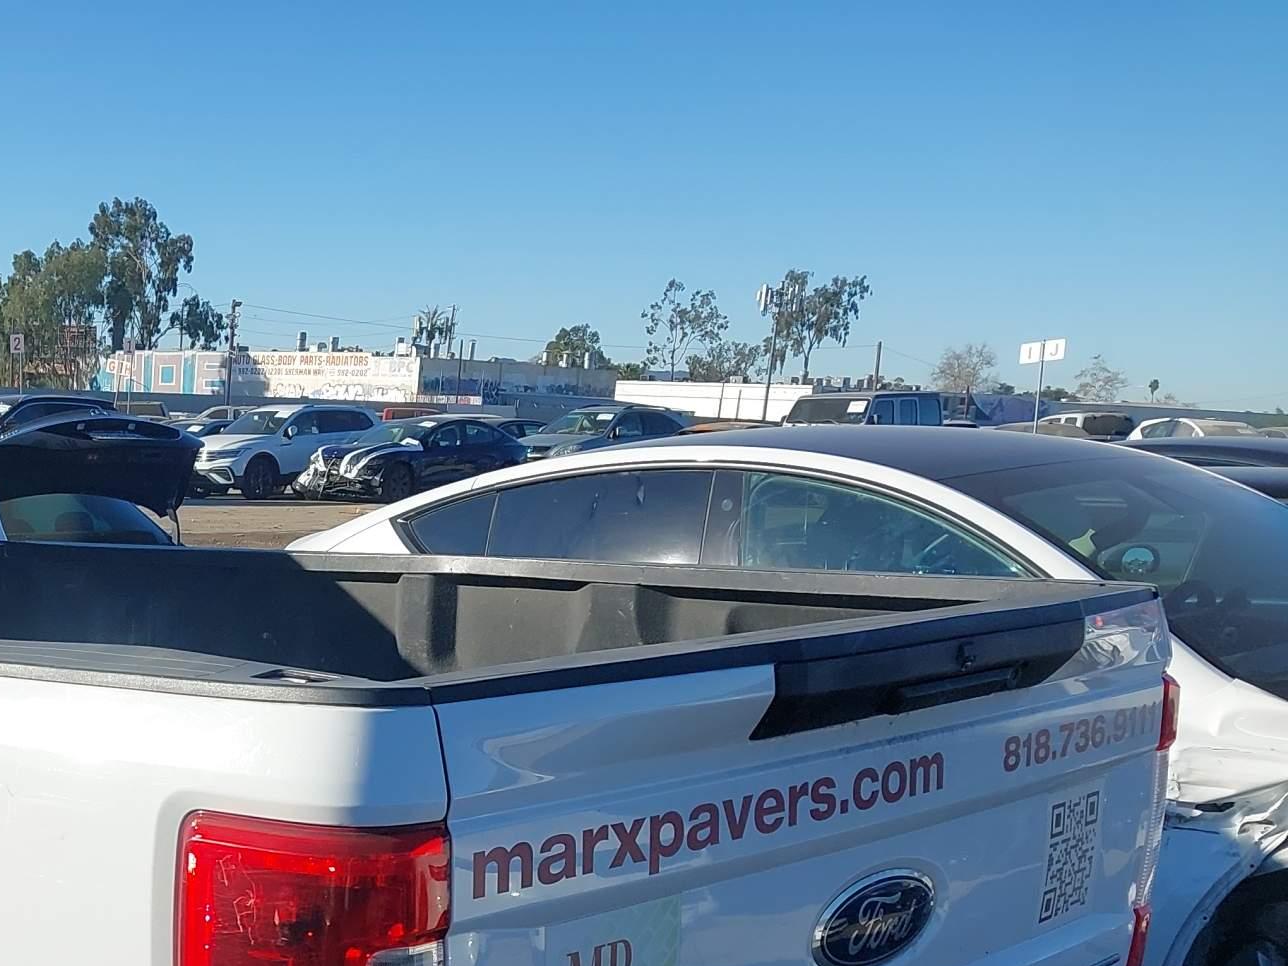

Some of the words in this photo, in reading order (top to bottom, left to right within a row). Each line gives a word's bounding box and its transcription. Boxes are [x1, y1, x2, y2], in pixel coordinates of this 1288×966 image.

[13, 337, 21, 351] 2
[233, 354, 251, 366] AUTO
[1049, 343, 1059, 357] J
[1003, 701, 1161, 773] 818.736.9111
[472, 751, 945, 899] marxpavers.com
[849, 891, 917, 955] Ford
